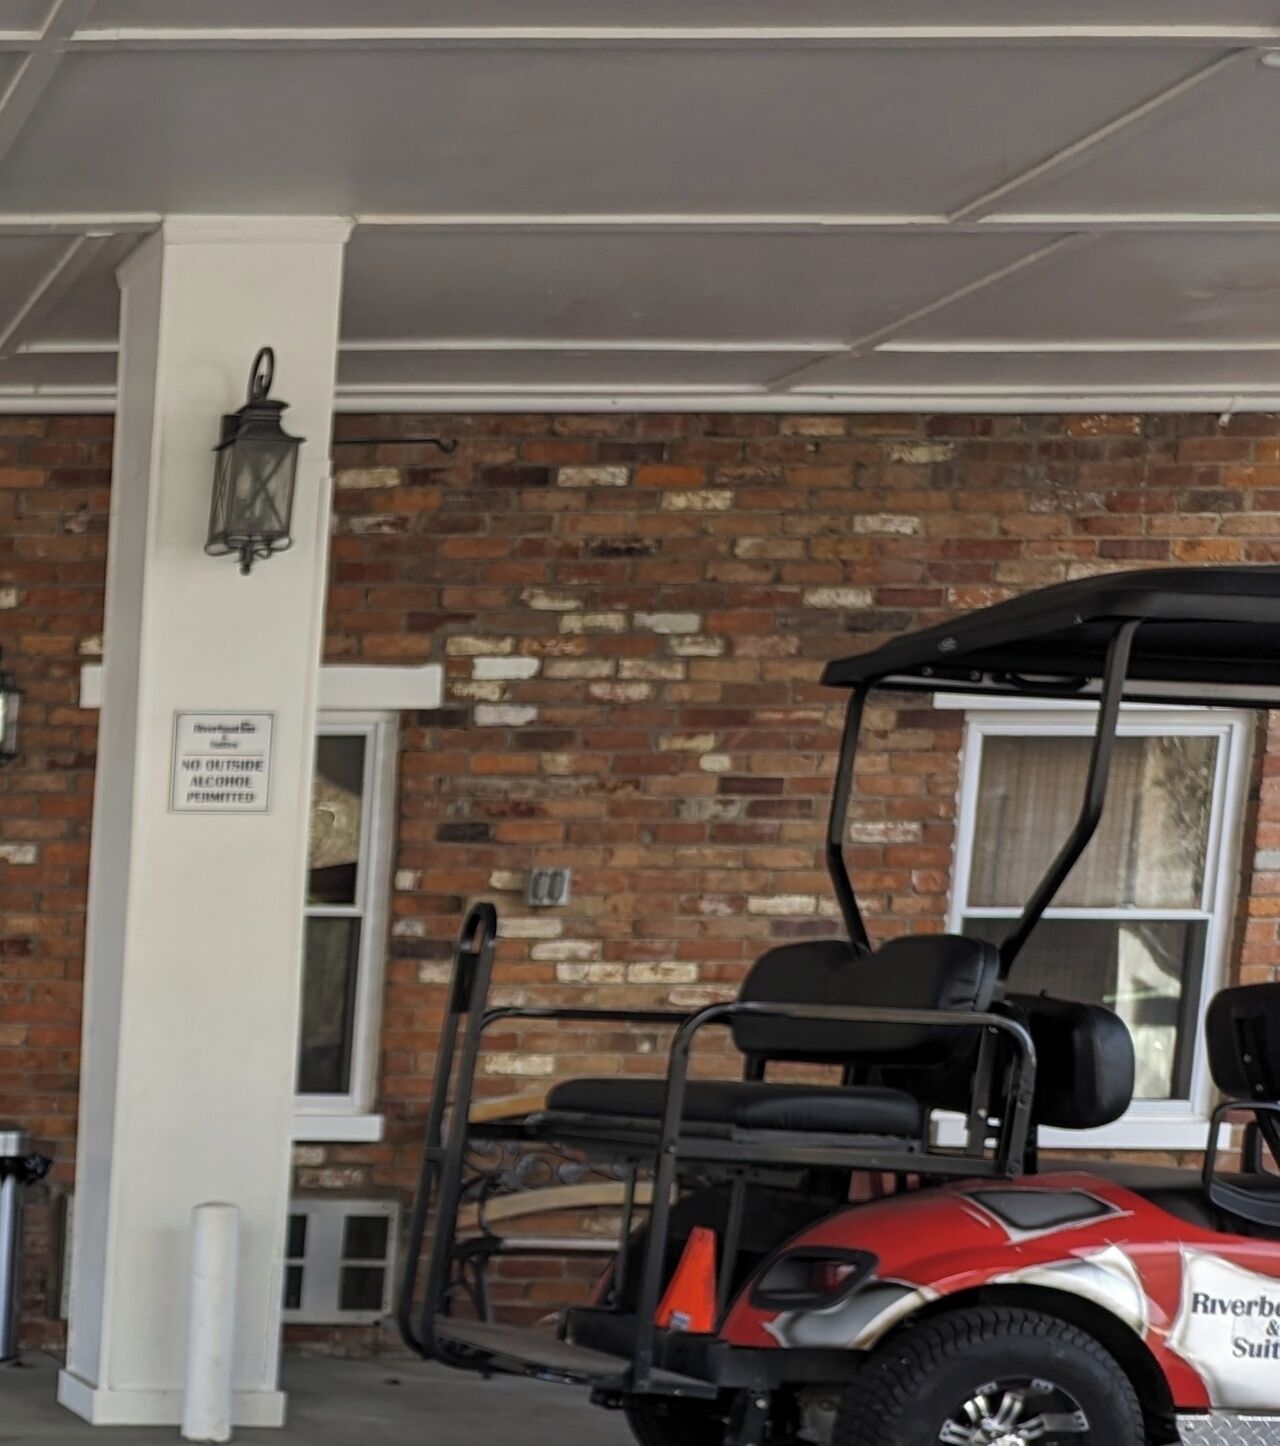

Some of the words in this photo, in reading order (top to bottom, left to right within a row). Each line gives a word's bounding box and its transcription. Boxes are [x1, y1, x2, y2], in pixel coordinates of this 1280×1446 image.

[181, 760, 200, 771] NO
[205, 760, 264, 772] OUTSIDE
[189, 776, 253, 788] ALCOHOL
[187, 792, 255, 803] PERMITTED
[1265, 1320, 1279, 1336] &
